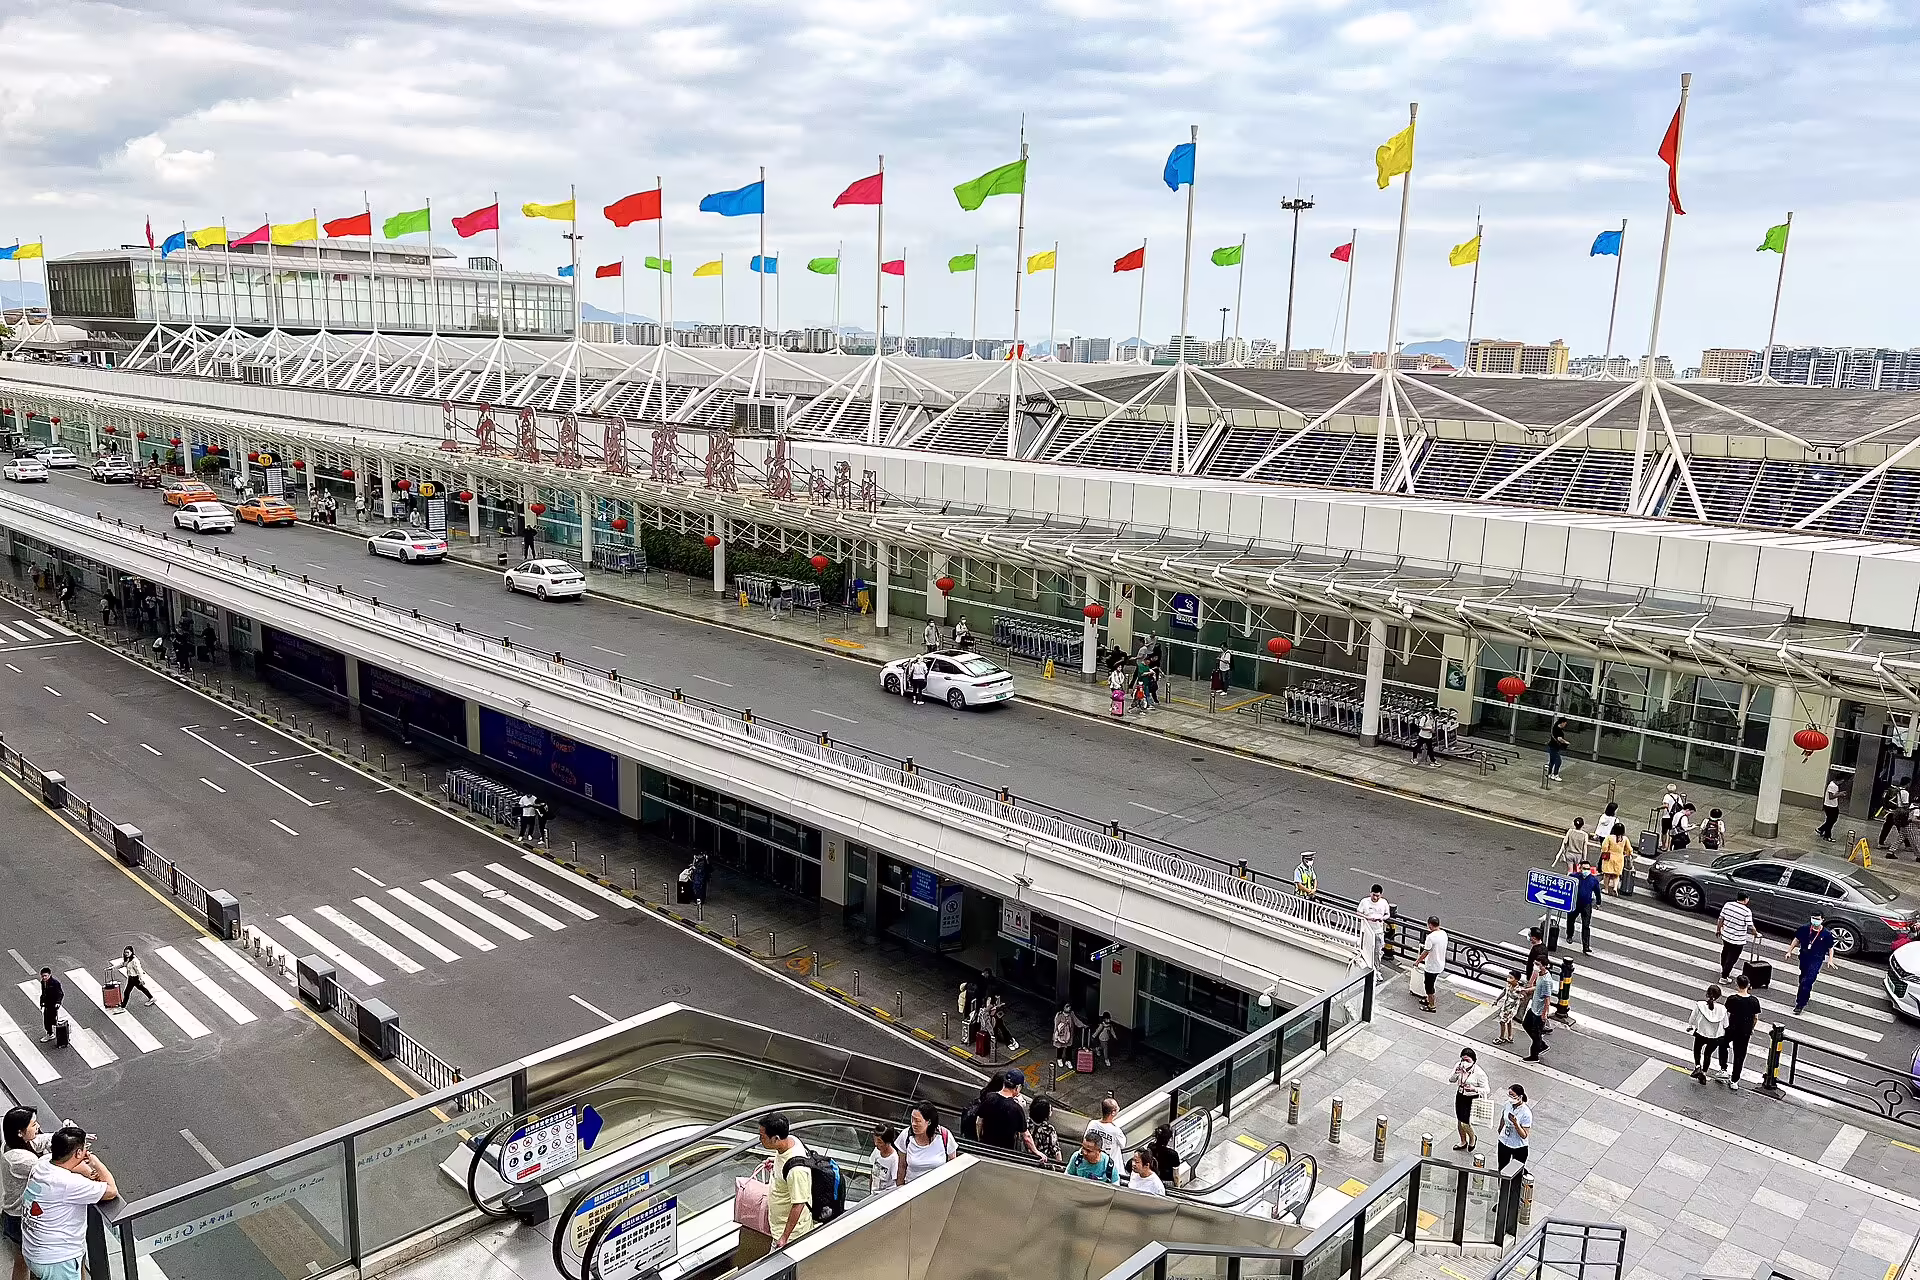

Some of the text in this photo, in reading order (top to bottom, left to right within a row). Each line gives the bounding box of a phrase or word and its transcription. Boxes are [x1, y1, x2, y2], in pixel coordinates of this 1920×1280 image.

[261, 456, 271, 464] T1
[423, 485, 433, 495] T1
[250, 1201, 261, 1209] To
[266, 1187, 291, 1202] Travel
